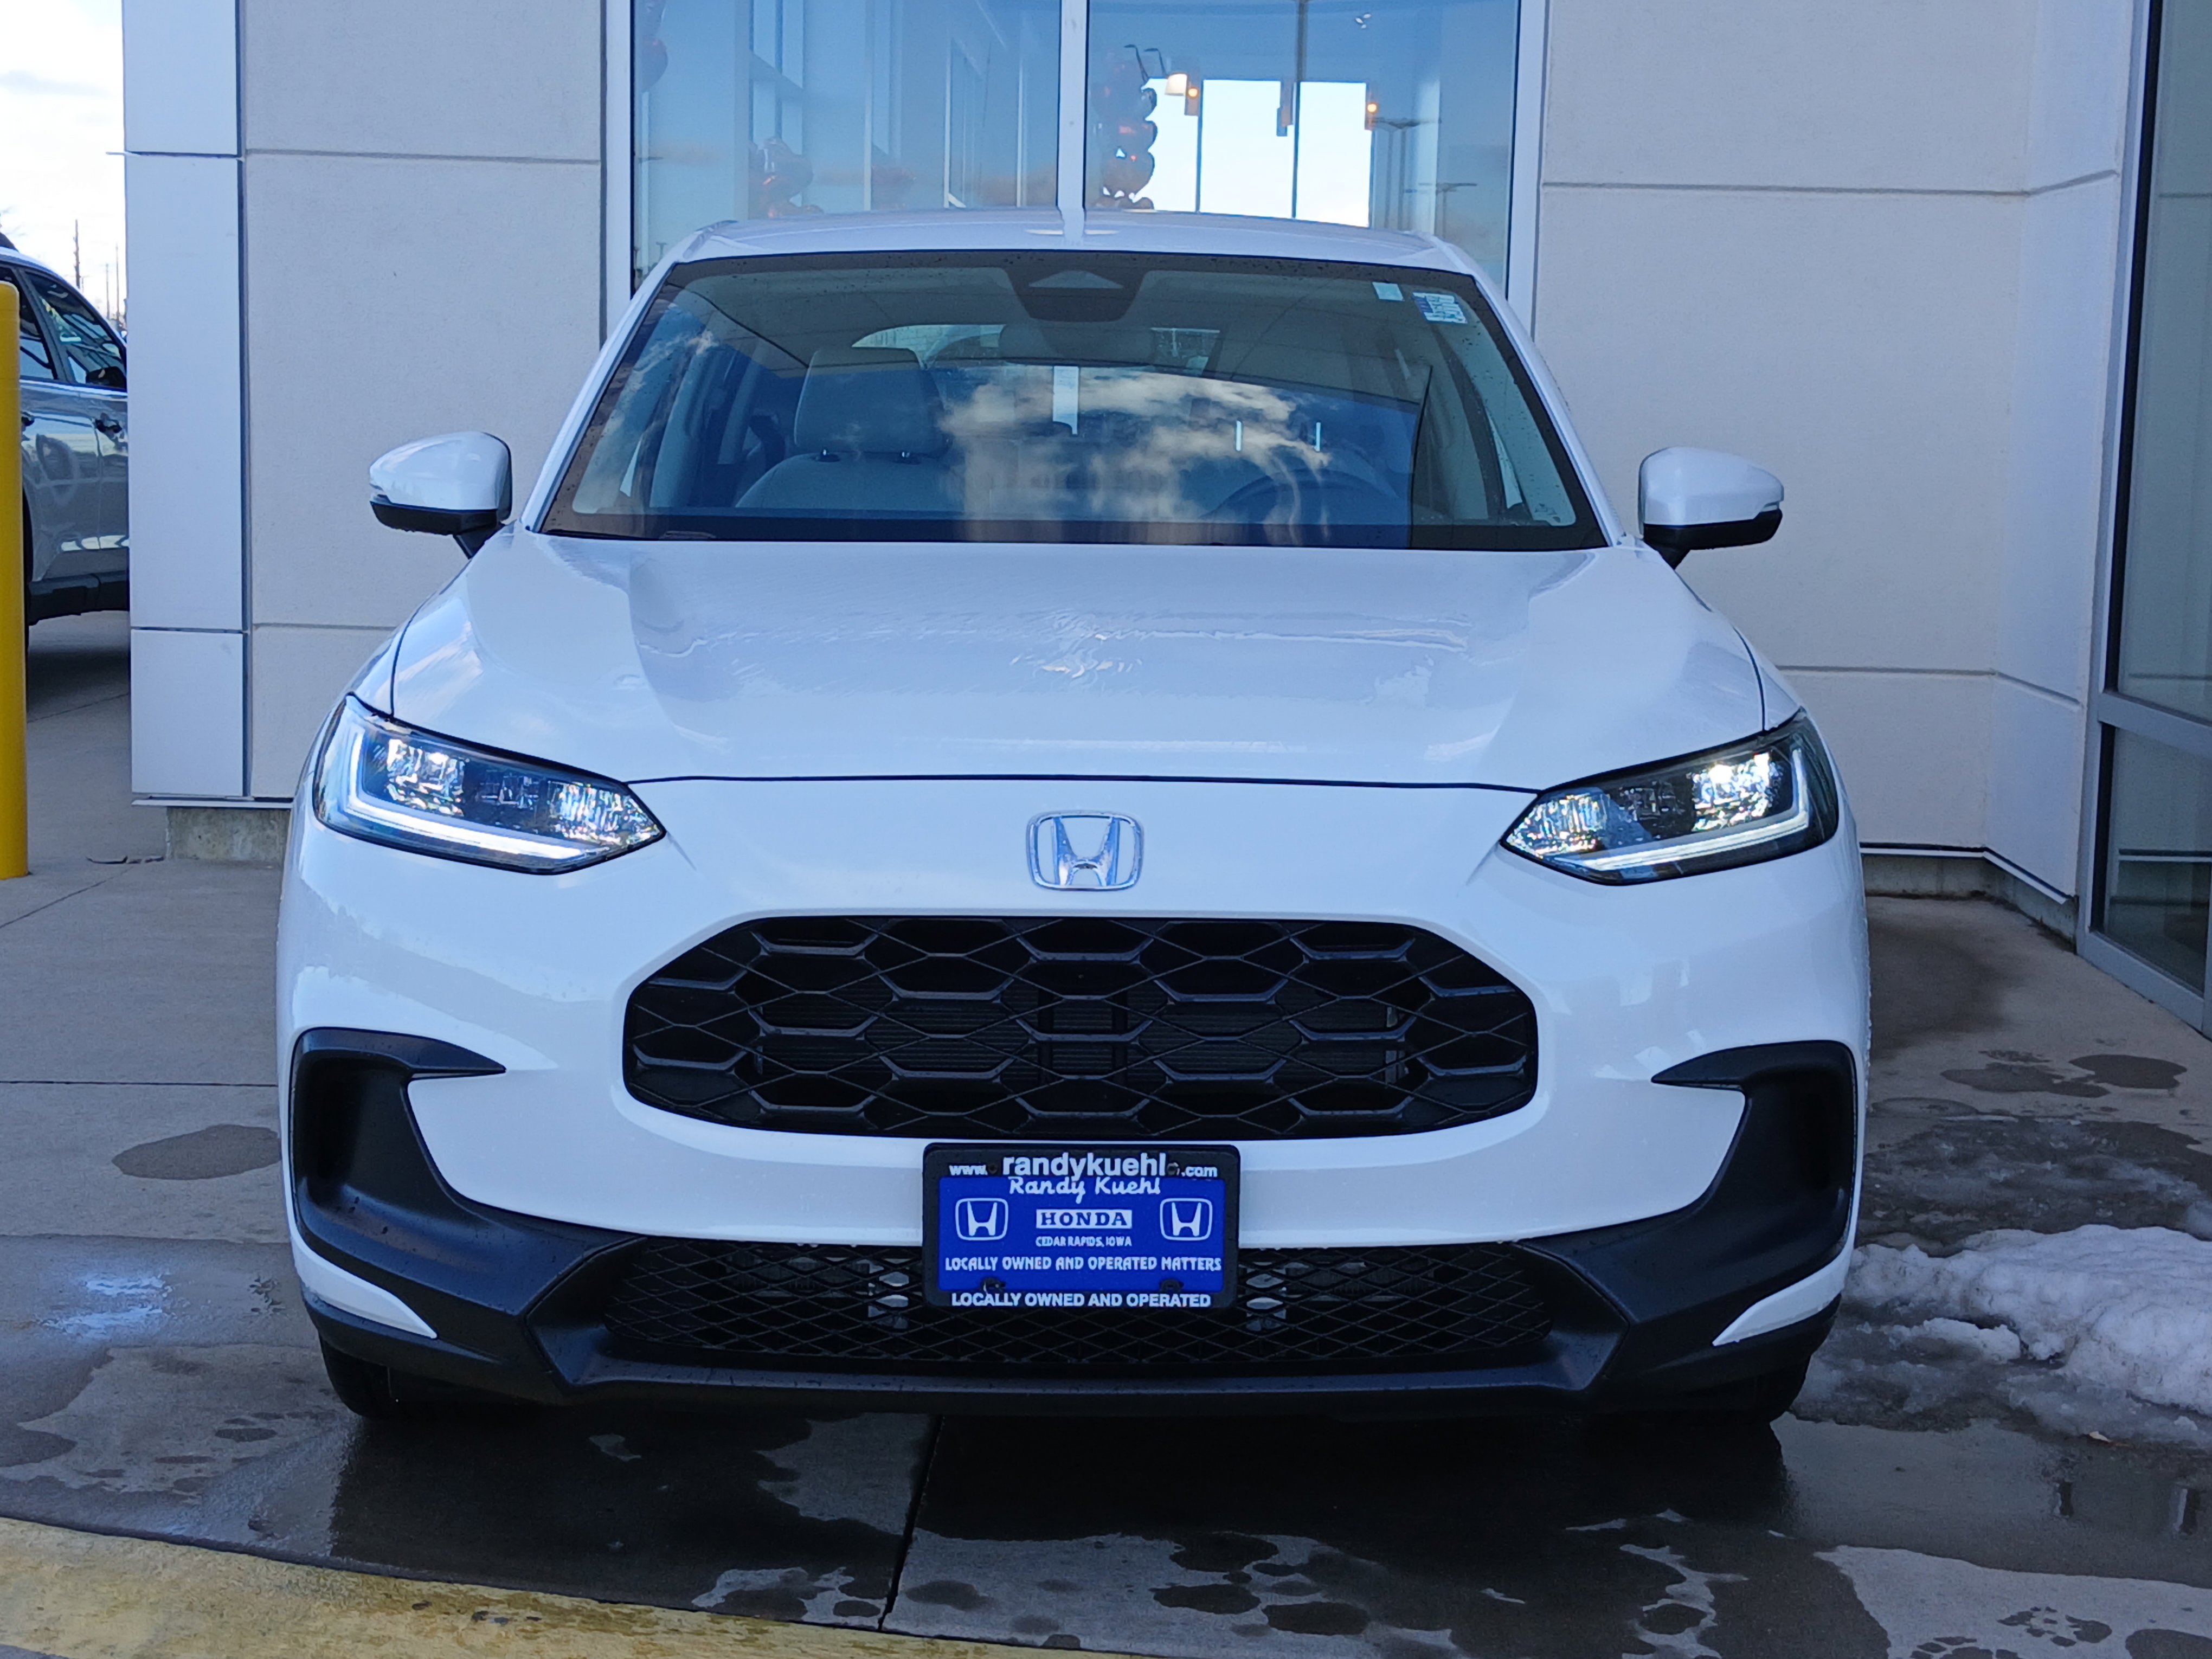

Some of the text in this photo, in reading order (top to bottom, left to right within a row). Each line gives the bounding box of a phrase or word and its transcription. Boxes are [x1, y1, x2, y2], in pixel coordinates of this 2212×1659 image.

[1003, 1152, 1166, 1181] randykuehl
[1181, 1166, 1218, 1177] .com
[1008, 1175, 1161, 1204] Randy Kuehl
[1040, 1212, 1127, 1226] HONDA
[1105, 1236, 1132, 1246] IOWA
[945, 1256, 1221, 1271] LOCALLY OWNED AND OPERATED MATTERS
[951, 1293, 1211, 1307] LOCALLY OWNED AND OPERATED
